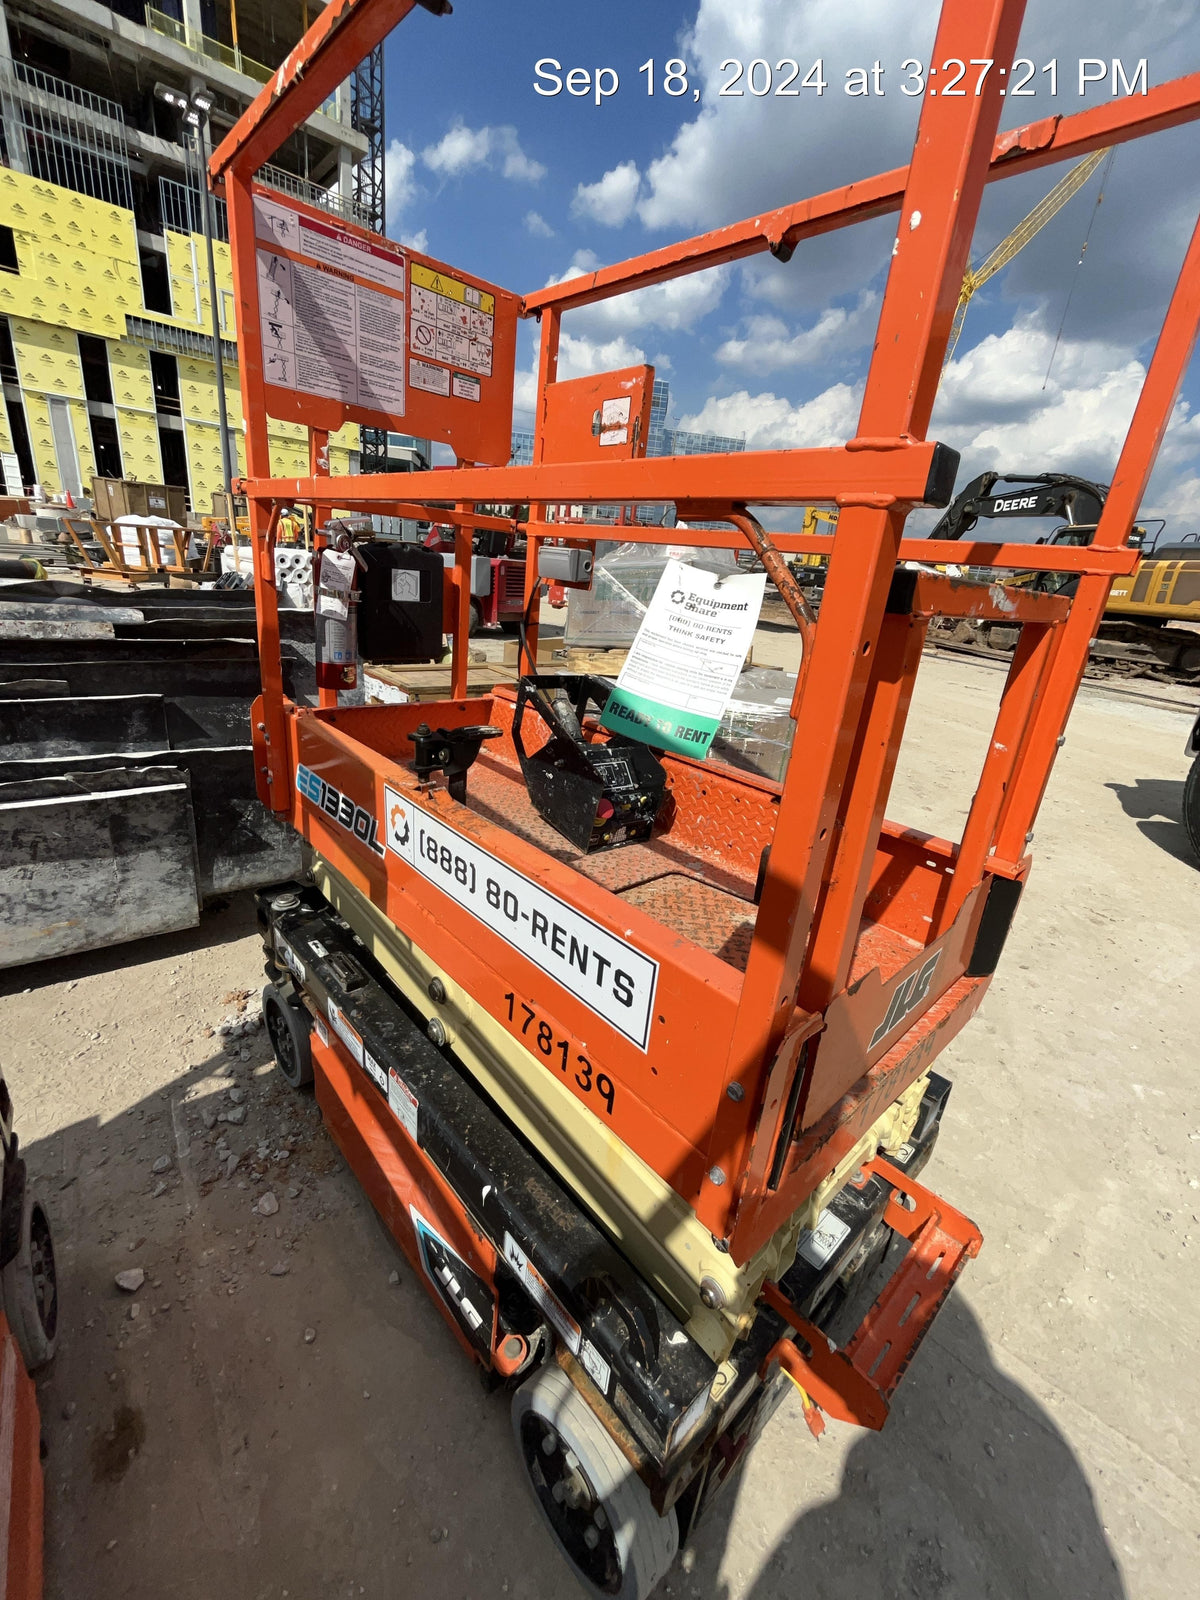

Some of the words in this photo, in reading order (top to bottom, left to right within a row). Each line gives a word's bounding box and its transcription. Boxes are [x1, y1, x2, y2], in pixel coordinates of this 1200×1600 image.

[343, 235, 372, 253] DANGER
[322, 264, 355, 282] WARNING
[993, 495, 1038, 513] DEERE
[684, 601, 718, 618] Share
[687, 592, 749, 612] Equipment
[668, 624, 694, 638] THINK
[694, 633, 727, 645] SAFETY
[608, 701, 654, 728] READY
[655, 718, 673, 735] TO
[674, 725, 712, 745] RENT
[297, 764, 386, 859] ES1330L
[419, 828, 476, 894] (888)
[486, 877, 636, 1009] 80-RENTS
[866, 947, 943, 1054] JLG
[504, 992, 616, 1115] 178139
[433, 1264, 484, 1331] JLG
